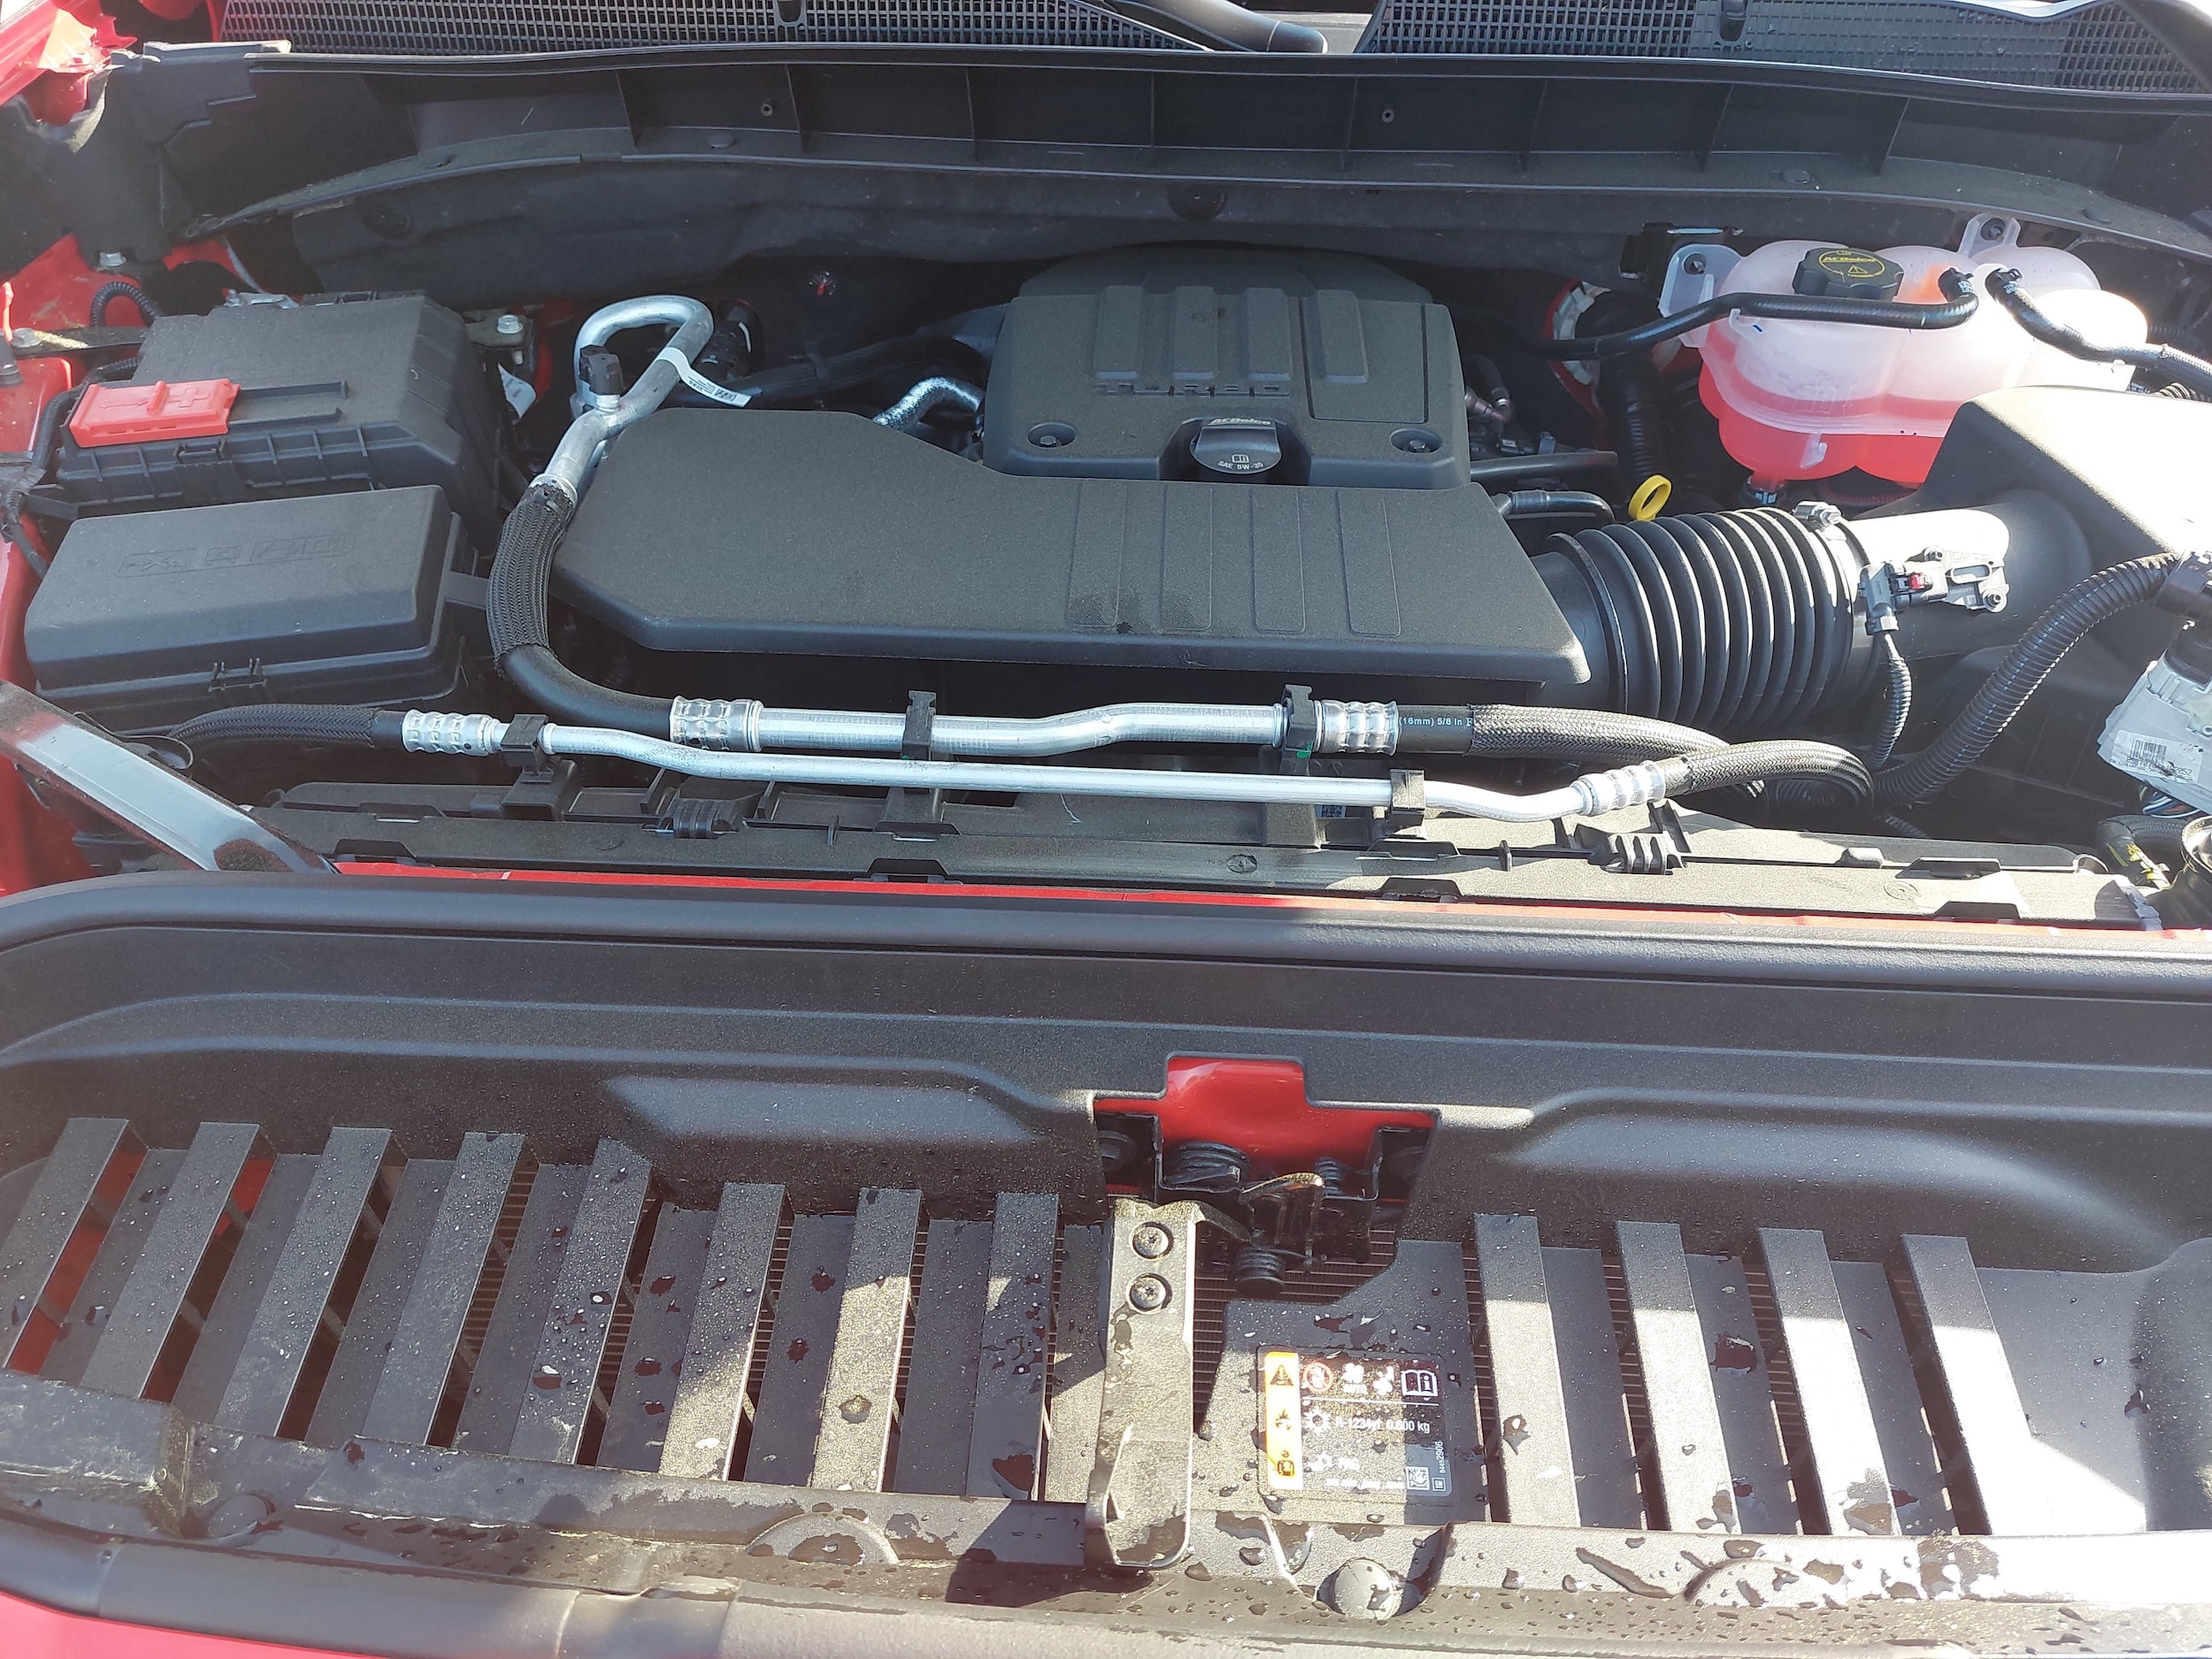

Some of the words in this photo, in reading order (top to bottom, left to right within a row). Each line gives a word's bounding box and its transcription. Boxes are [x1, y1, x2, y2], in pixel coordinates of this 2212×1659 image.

[1217, 460, 1233, 469] SAE
[1399, 717, 1433, 726] (16mm)
[1417, 1421, 1430, 1433] kg
